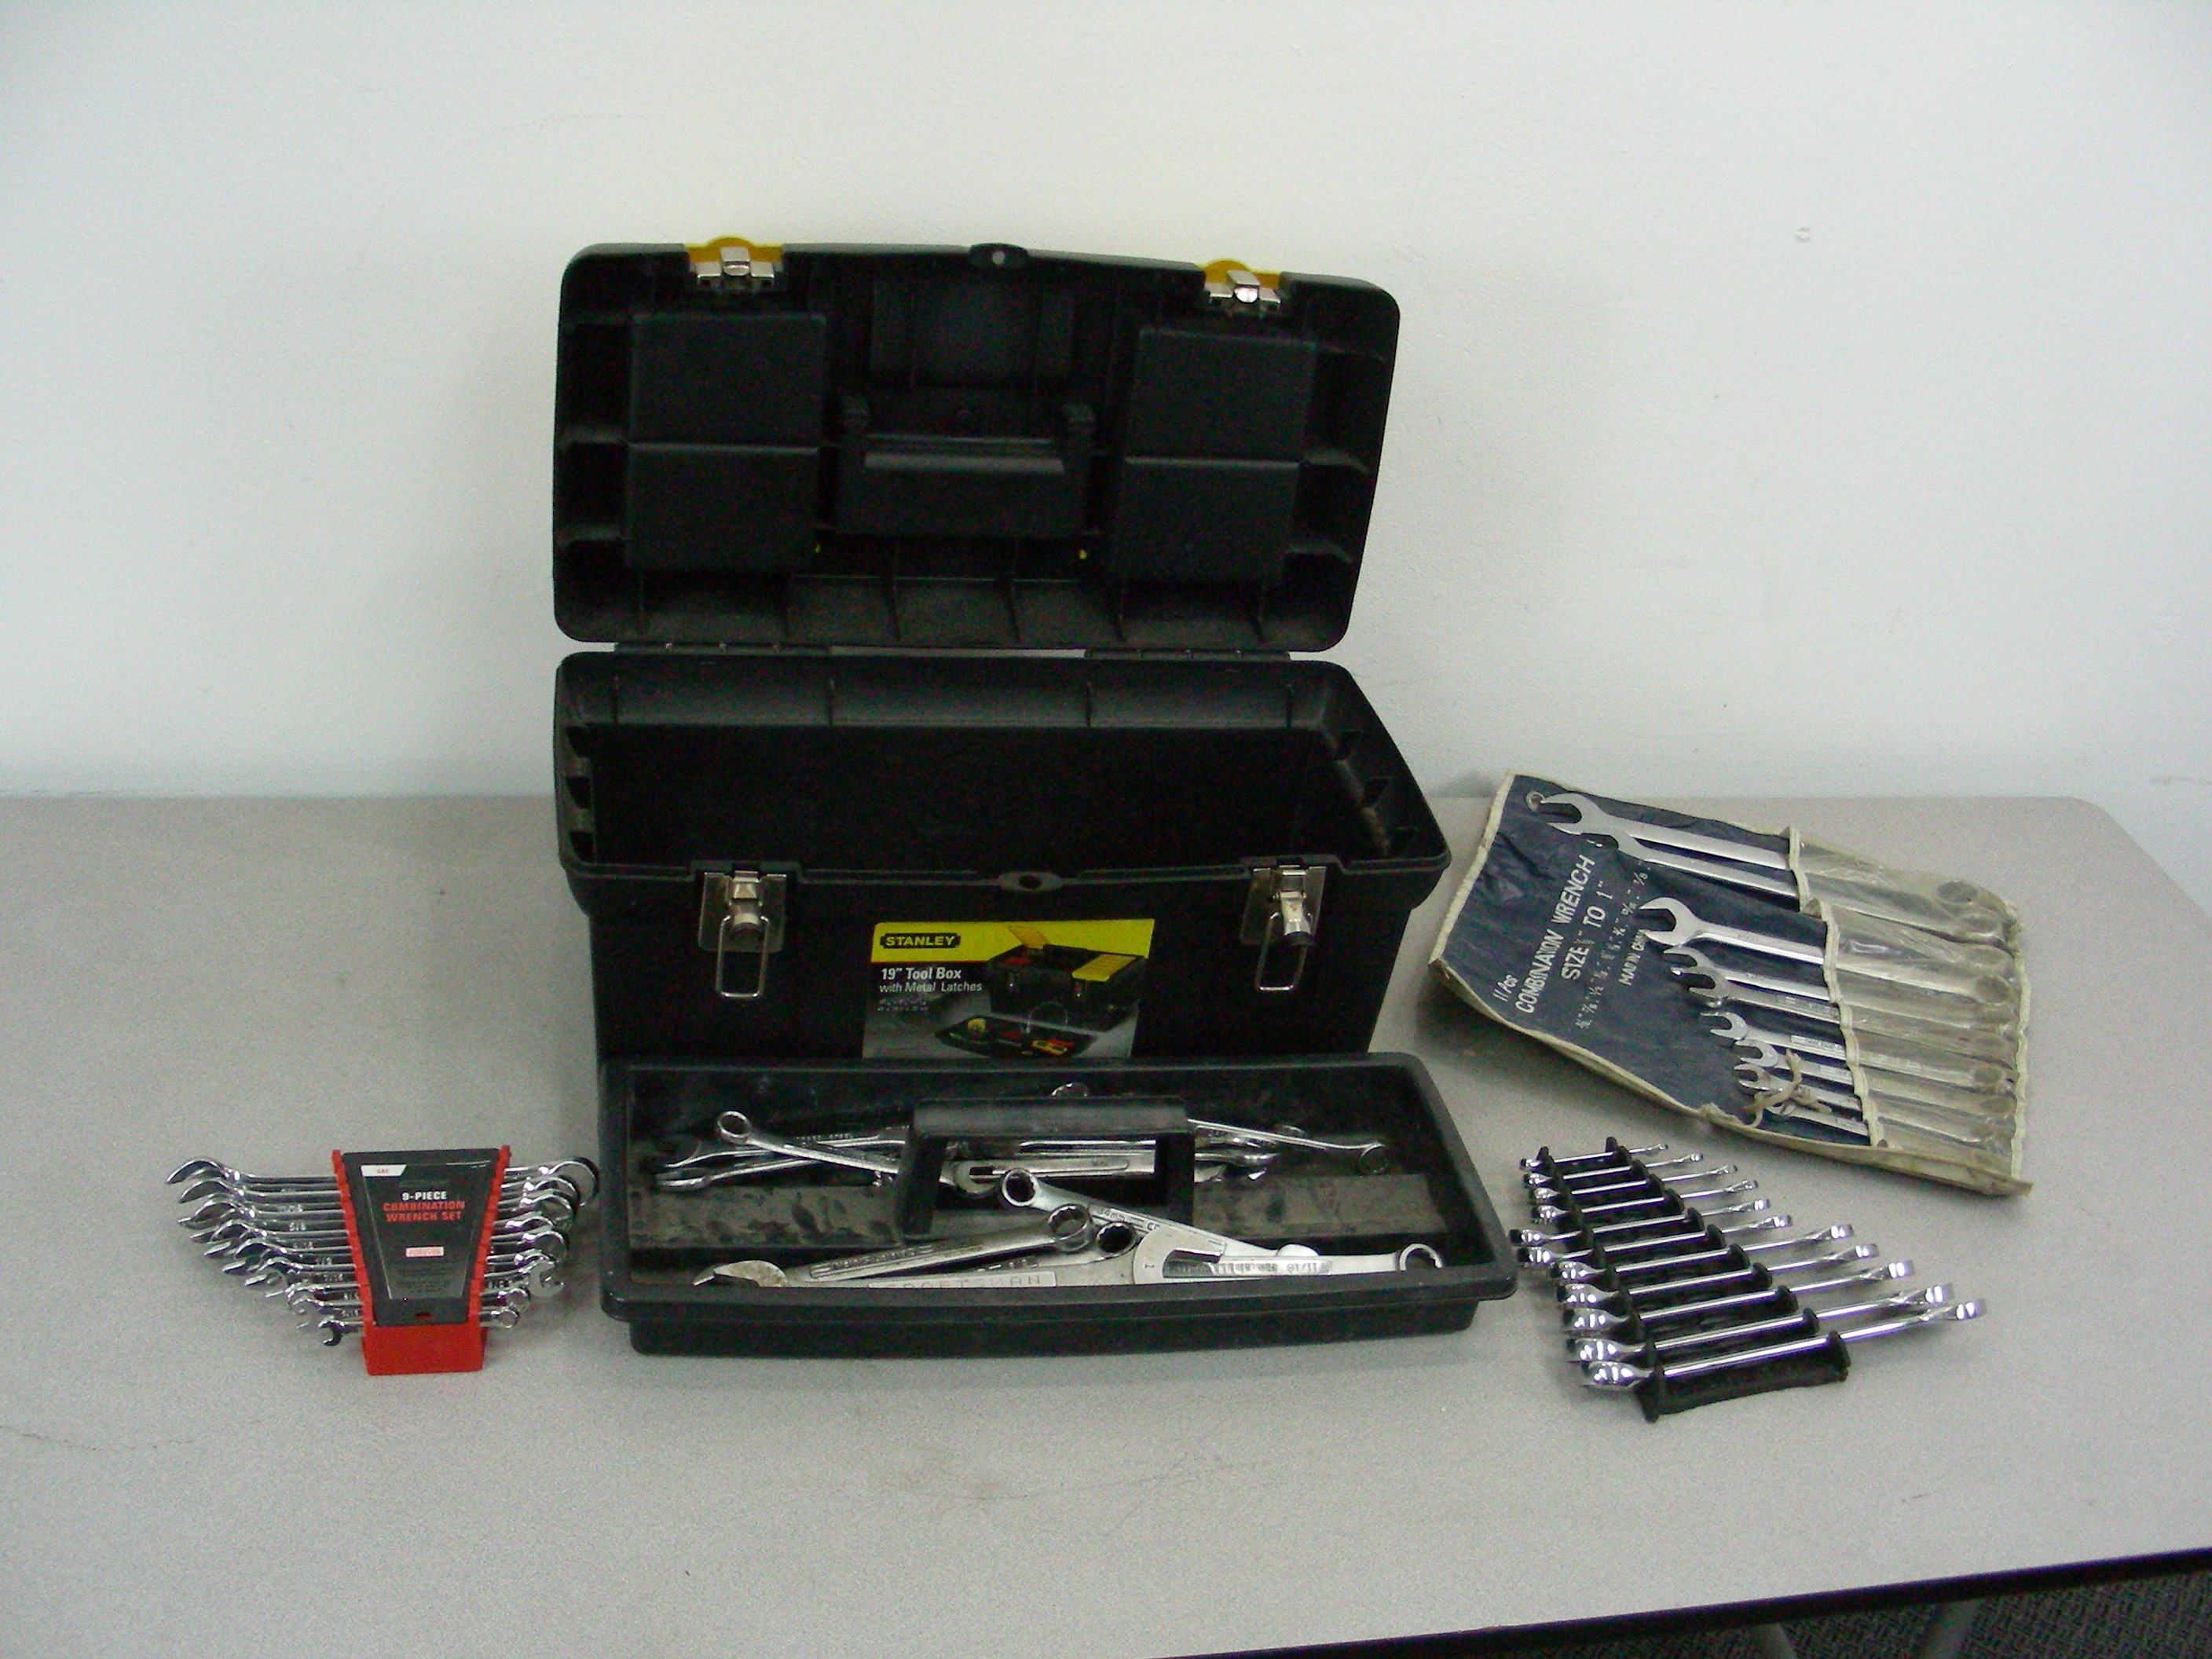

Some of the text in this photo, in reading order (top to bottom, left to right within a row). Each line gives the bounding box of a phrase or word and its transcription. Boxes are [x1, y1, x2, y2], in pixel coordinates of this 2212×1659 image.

[1515, 928, 1565, 1013] COMBINATION
[1551, 854, 1596, 924] WRENCH
[885, 936, 955, 947] STANLEY
[1561, 946, 1590, 980] SIZE
[1582, 905, 1606, 928] TO
[881, 966, 962, 980] 19" Tool Box
[879, 980, 983, 993] with Metal Latches
[401, 1191, 448, 1202] 9-PIECE
[383, 1200, 466, 1212] COMBINATION
[386, 1210, 462, 1223] WRENCH SET
